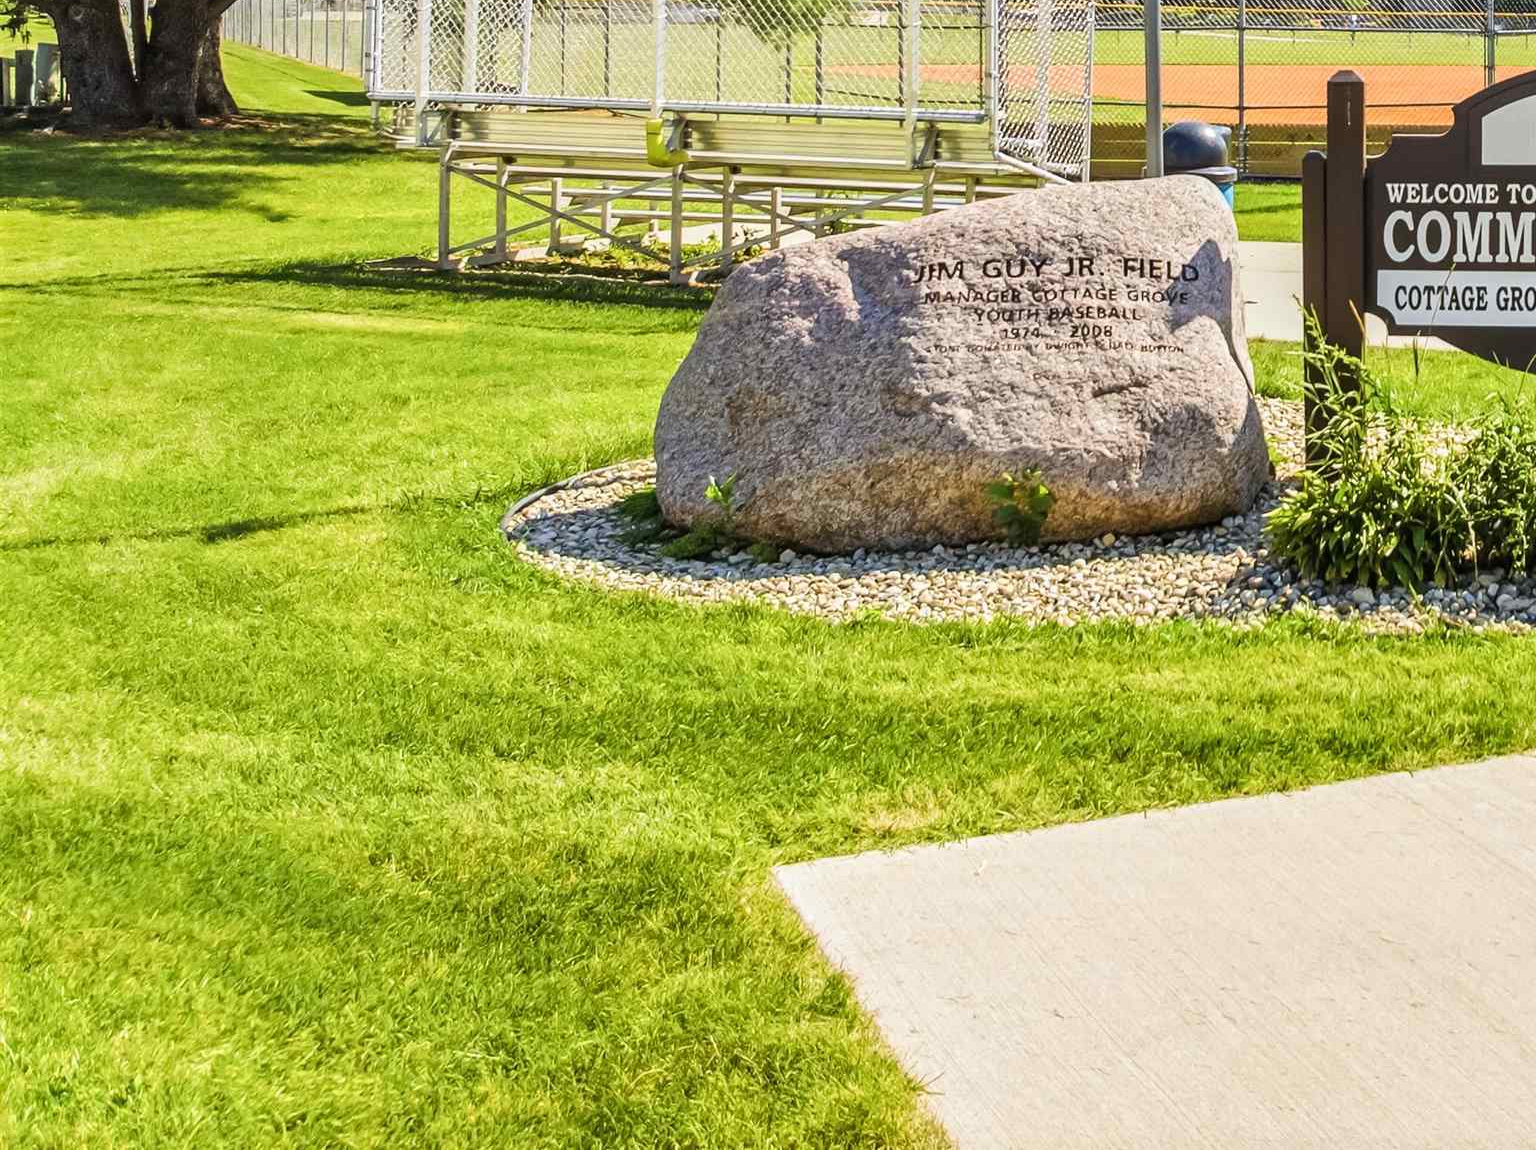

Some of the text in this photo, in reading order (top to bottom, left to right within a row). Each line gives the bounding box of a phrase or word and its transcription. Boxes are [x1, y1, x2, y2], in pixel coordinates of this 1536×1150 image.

[1385, 182, 1500, 204] WELCOME
[911, 256, 1200, 283] JIM GUY JR. FIELD
[924, 288, 1188, 305] MANAGER COTTAGE GROVE
[1394, 285, 1489, 312] COTTAGE
[974, 306, 1141, 322] YOUTH BASEBALL
[1001, 327, 1040, 339] 1974
